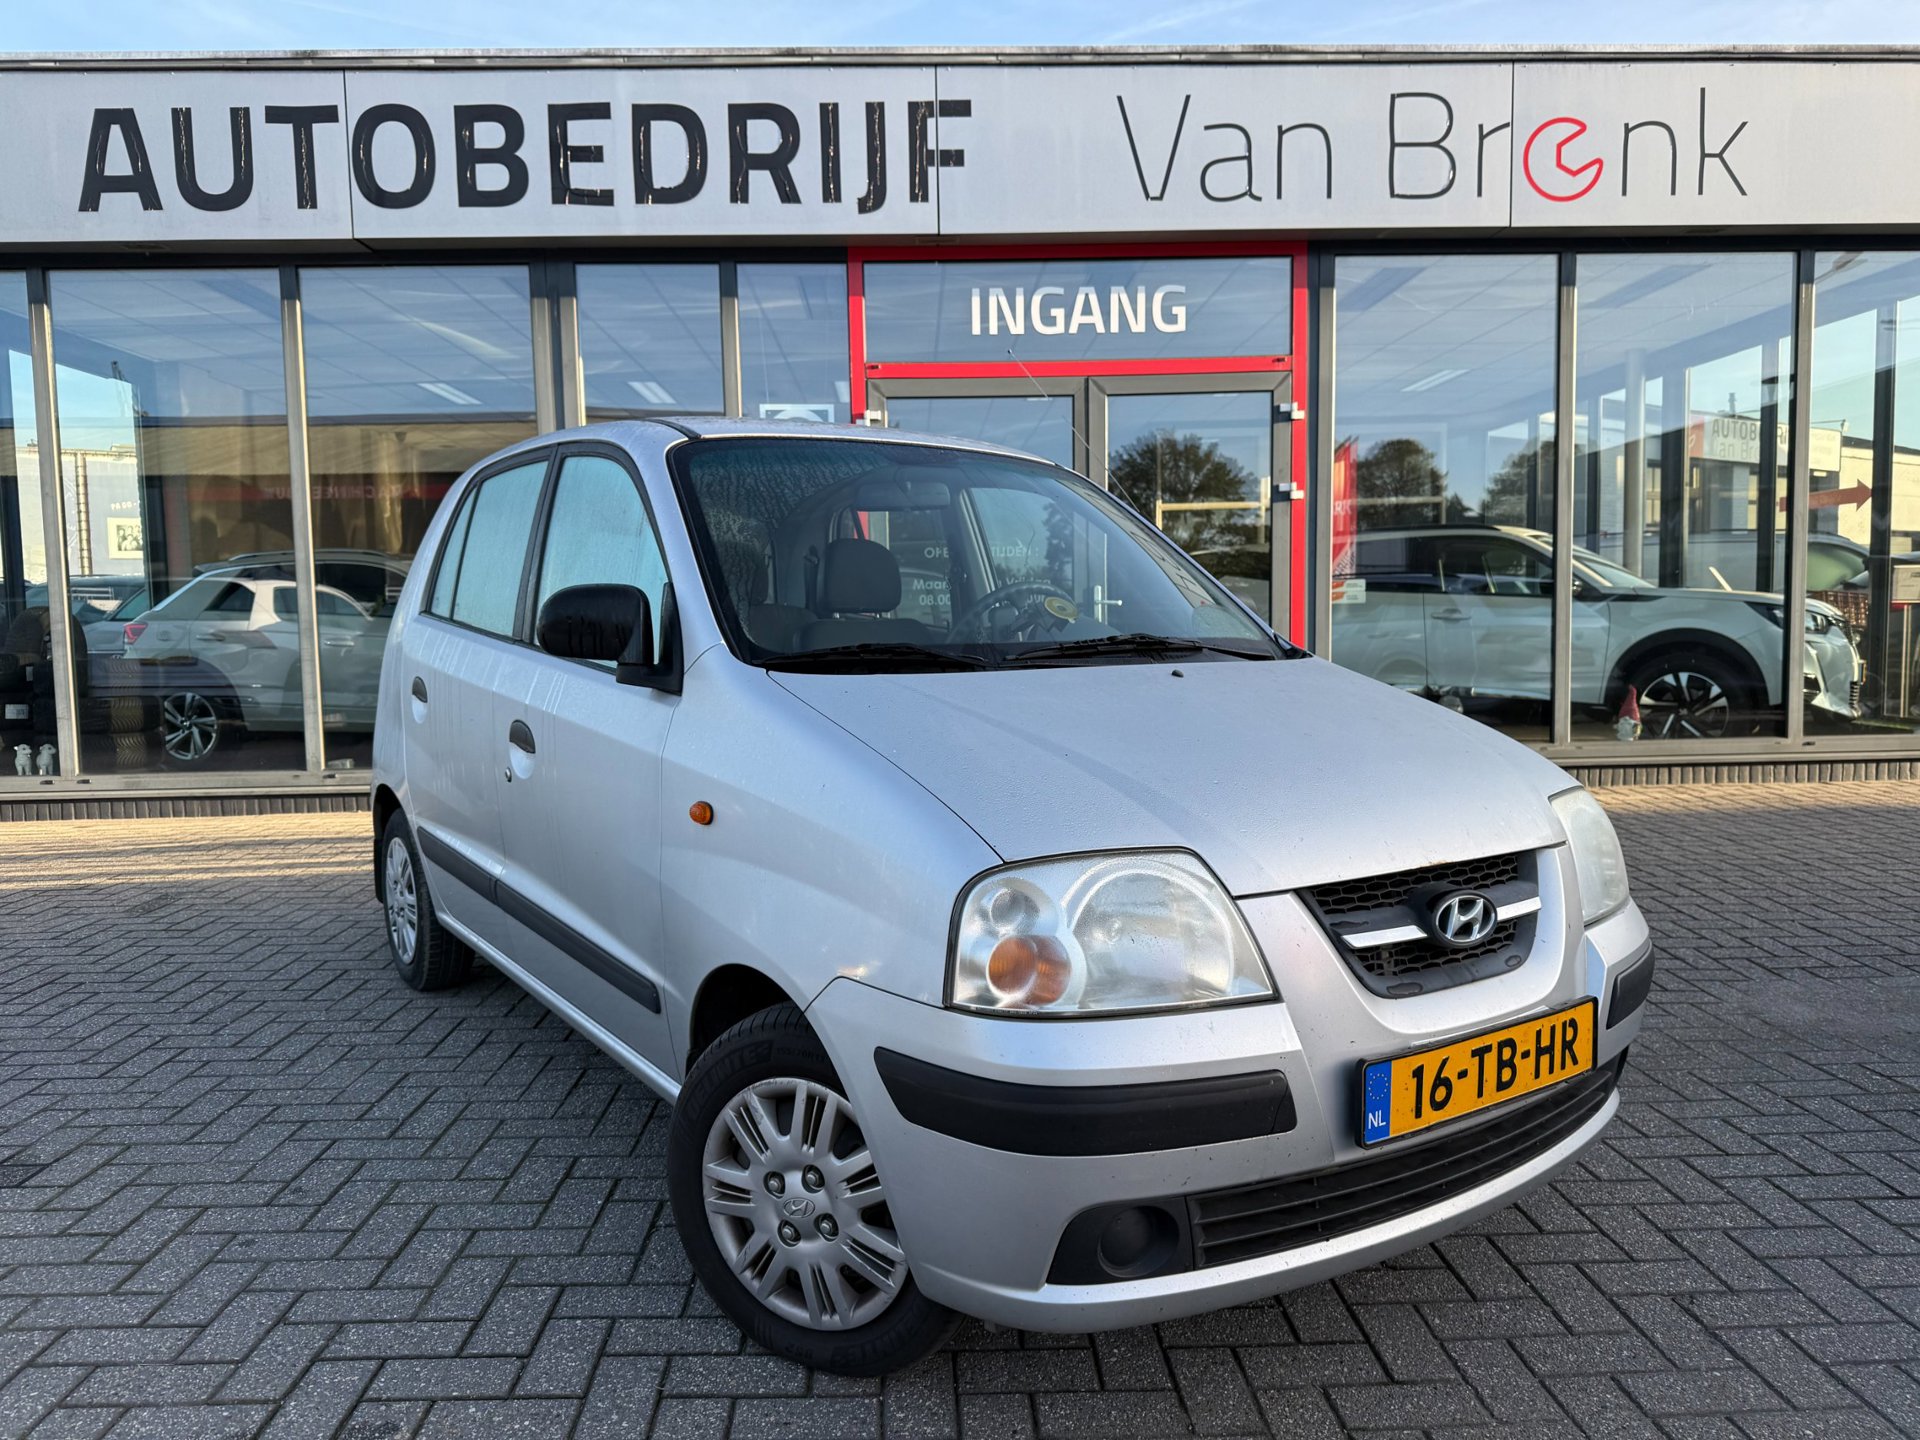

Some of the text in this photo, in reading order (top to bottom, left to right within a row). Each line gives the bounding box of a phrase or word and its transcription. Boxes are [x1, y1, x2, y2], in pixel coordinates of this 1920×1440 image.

[78, 99, 972, 214] AUTOBEDRIJF
[1116, 93, 1333, 202] Van
[971, 285, 1187, 335] INGANG
[1411, 1016, 1579, 1119] 16-TB-HR
[1368, 1110, 1387, 1130] NL
